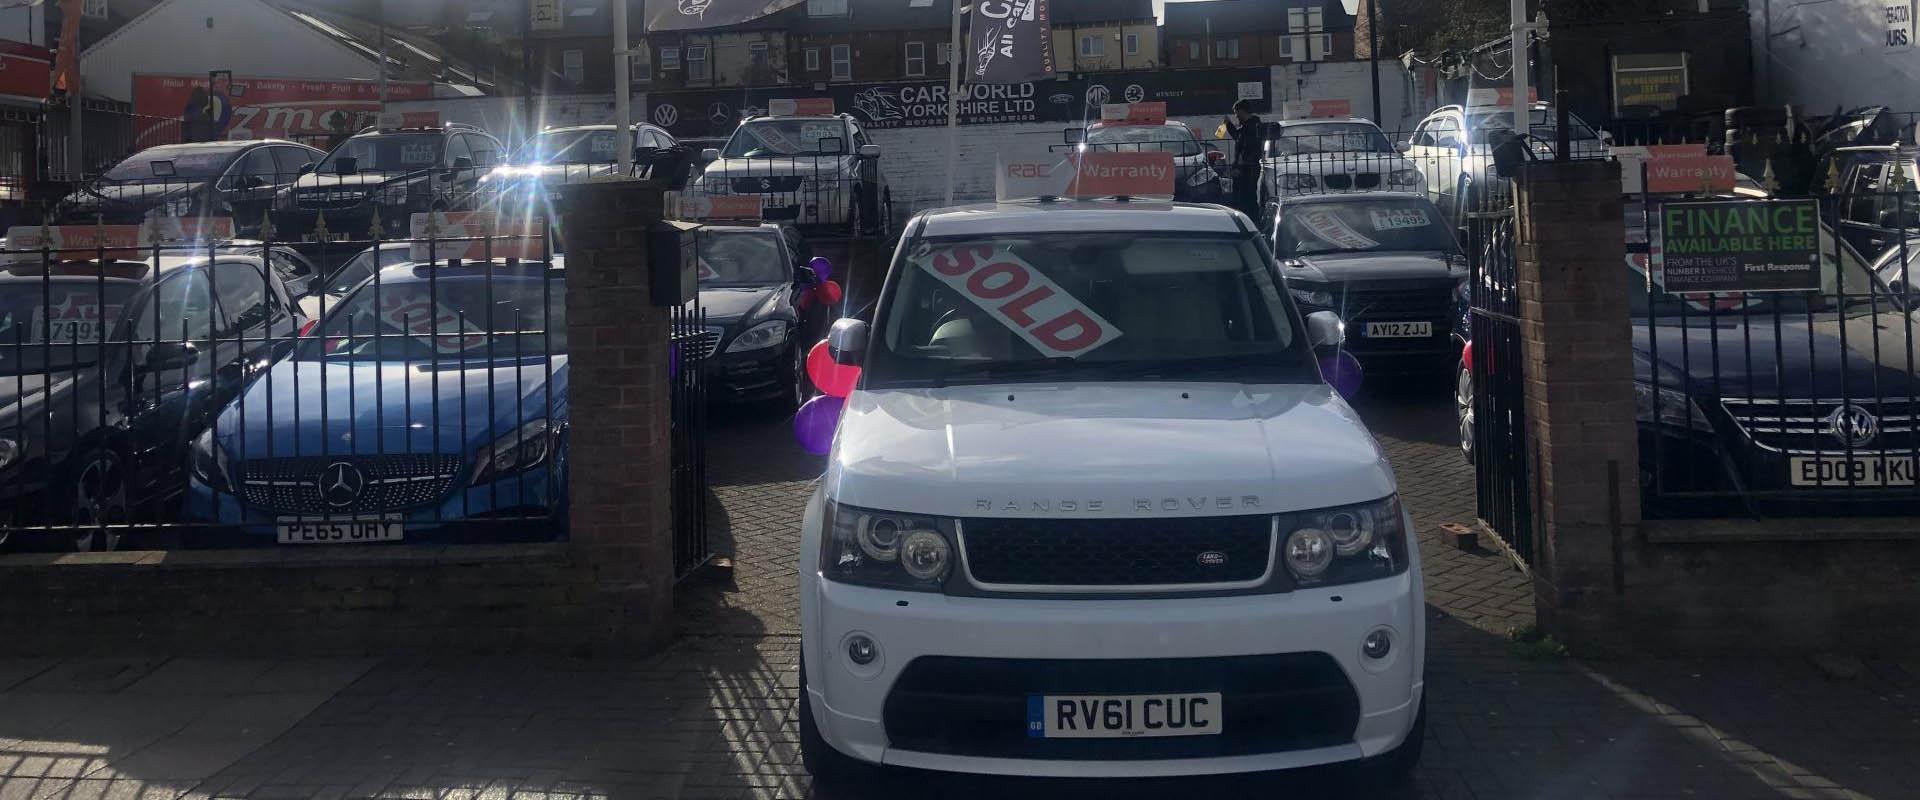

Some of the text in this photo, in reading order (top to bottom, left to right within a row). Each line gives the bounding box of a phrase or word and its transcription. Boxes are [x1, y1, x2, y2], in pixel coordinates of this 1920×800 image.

[1001, 34, 1013, 58] All
[1040, 27, 1052, 72] QUALITY
[900, 86, 947, 103] CAR
[953, 82, 1035, 101] WORLD
[901, 99, 1035, 117] YORKSHIRE LTD
[861, 119, 899, 129] UALITY
[1083, 164, 1167, 180] Warranty
[1666, 205, 1815, 236] FINANCE
[1666, 235, 1815, 253] AVAILABLE HERE
[1667, 256, 1737, 267] FROM THE UK'S
[1744, 263, 1811, 273] First Response
[1667, 267, 1700, 275] NUMBER
[932, 244, 1103, 352] SOLD
[1372, 322, 1428, 336] AY12 ZJJ
[976, 495, 1261, 512] RANGE ROVER
[288, 522, 342, 540] PE65
[1057, 698, 1209, 730] RV61 CUC
